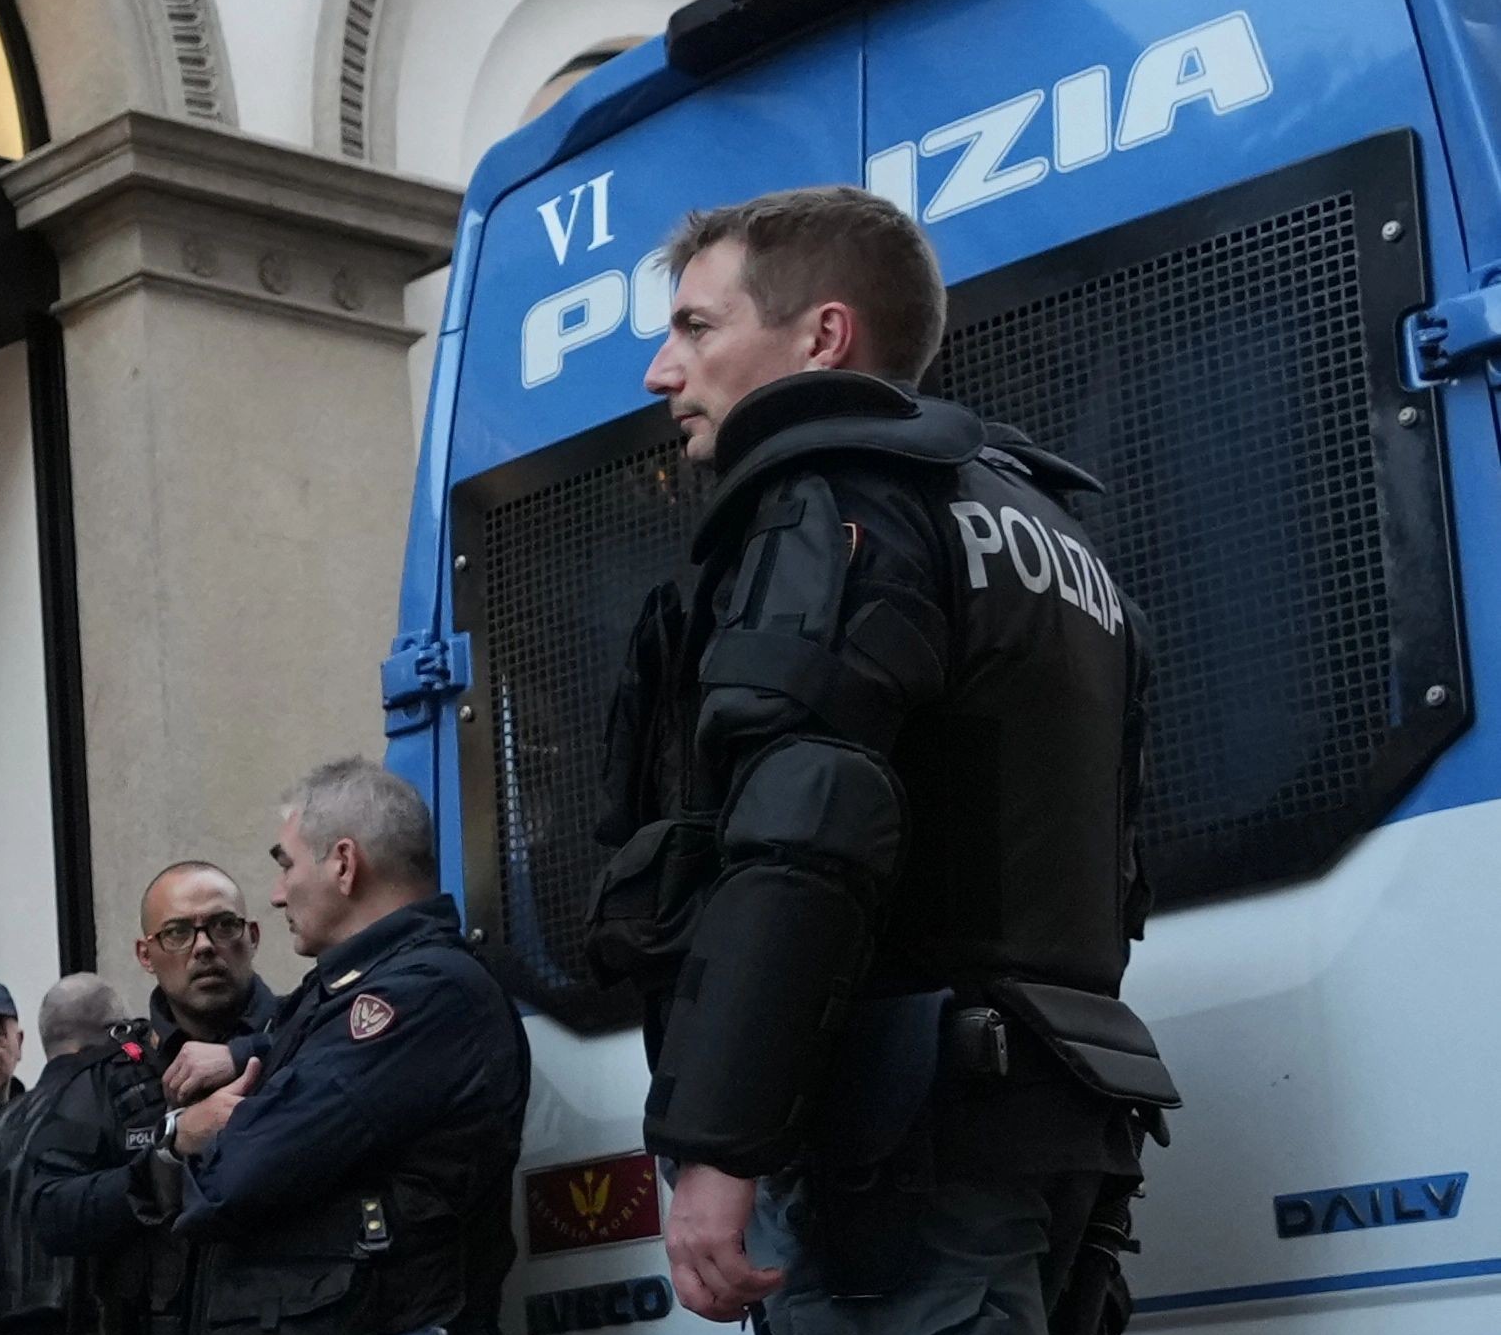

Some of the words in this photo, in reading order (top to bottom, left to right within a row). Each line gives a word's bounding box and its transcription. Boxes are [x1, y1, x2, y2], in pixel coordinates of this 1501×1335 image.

[521, 10, 1274, 390] PIZIA
[537, 170, 615, 266] VI
[949, 501, 1124, 637] POLIZIA
[1275, 1177, 1461, 1239] DAILY
